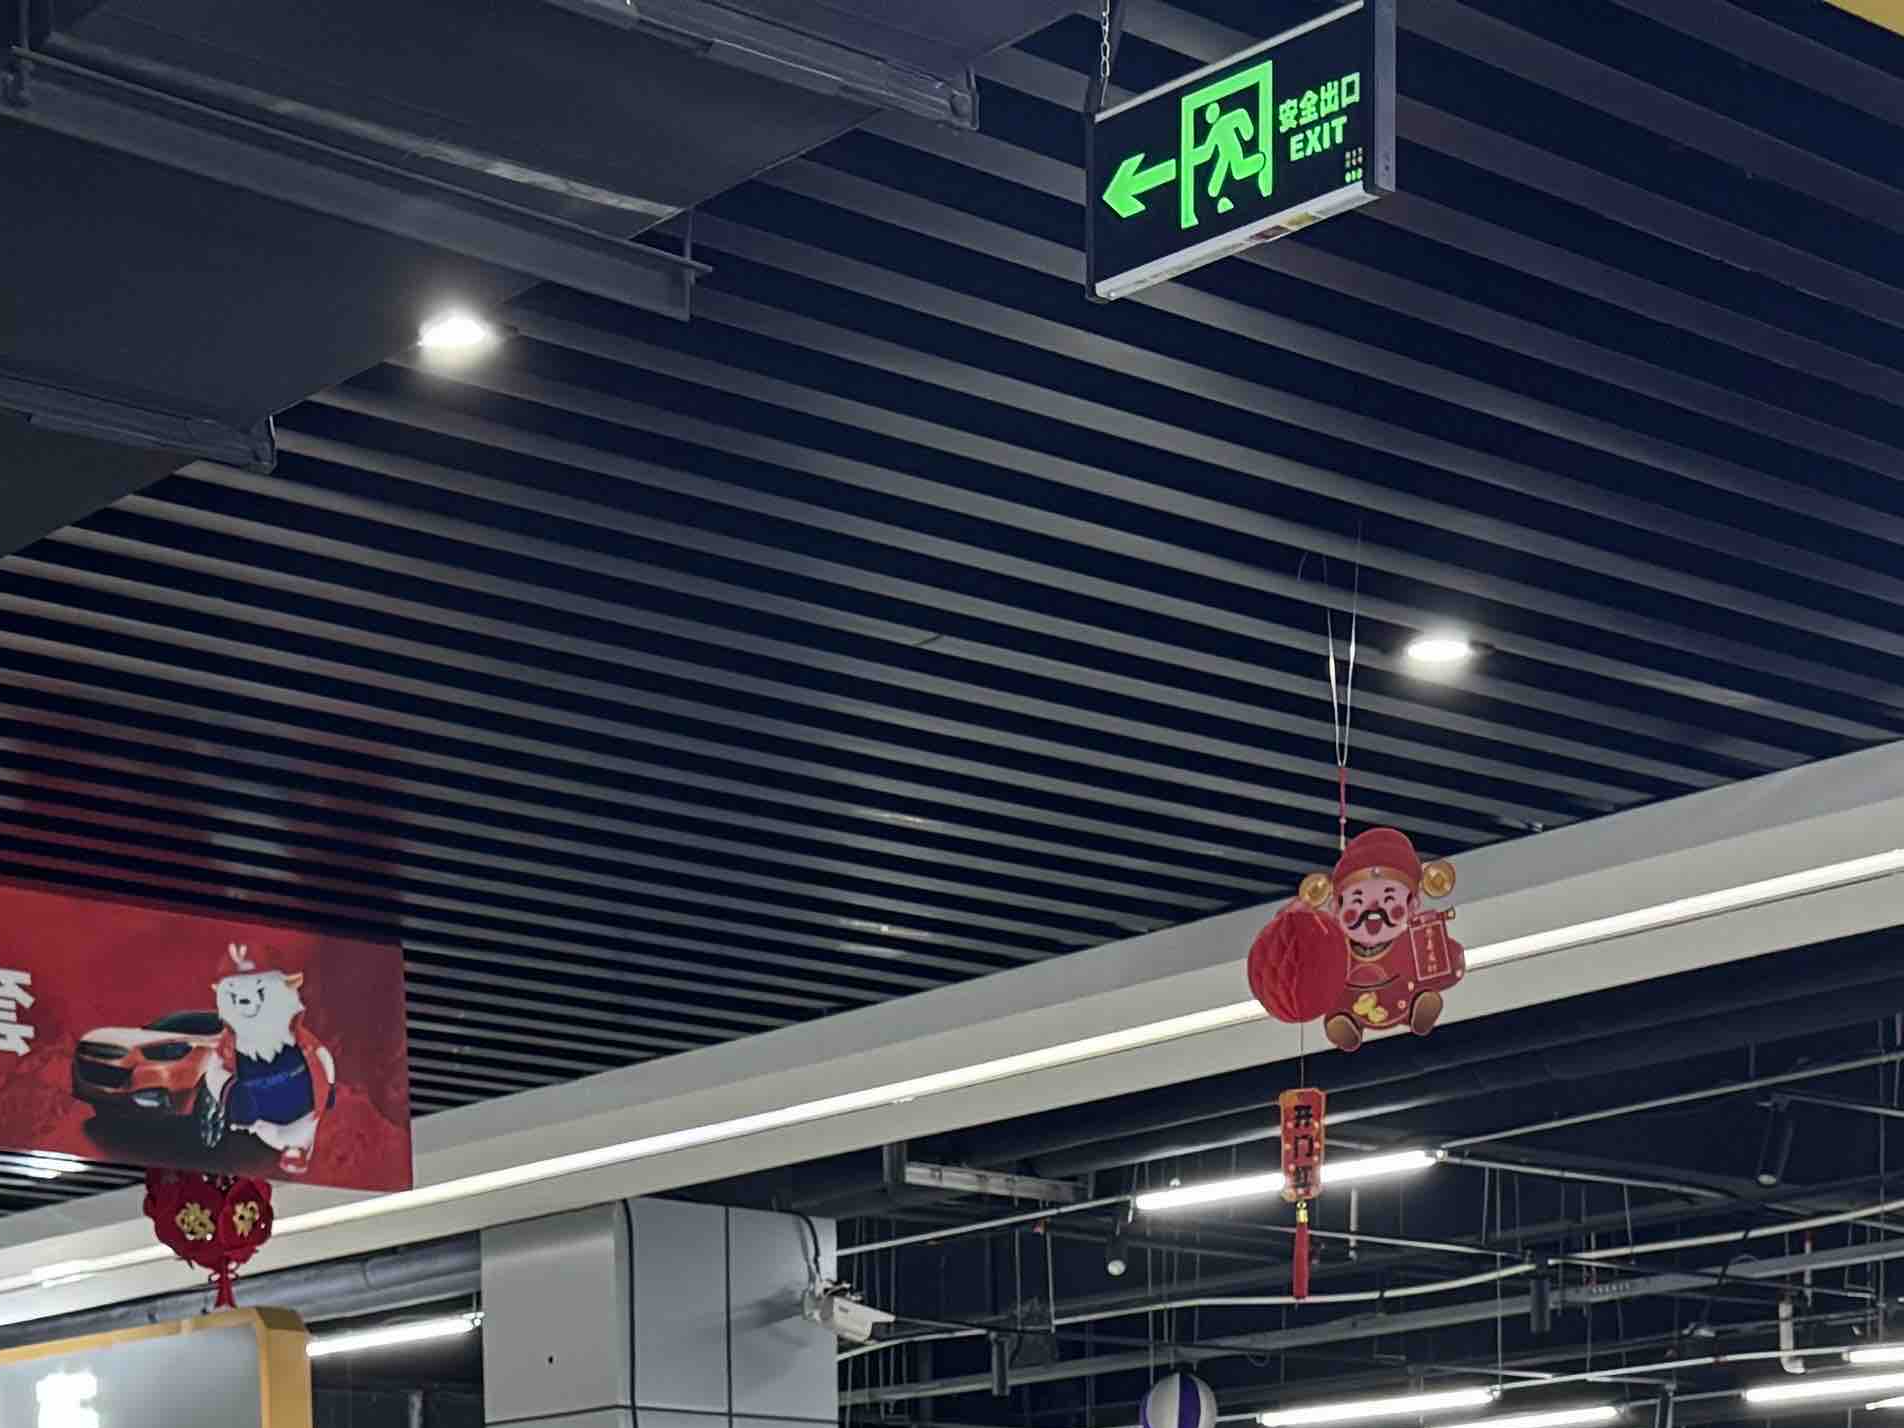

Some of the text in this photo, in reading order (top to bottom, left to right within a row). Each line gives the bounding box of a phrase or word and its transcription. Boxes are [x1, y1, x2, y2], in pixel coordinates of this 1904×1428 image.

[1279, 72, 1361, 132] 安全出口
[1289, 116, 1348, 161] EXIT
